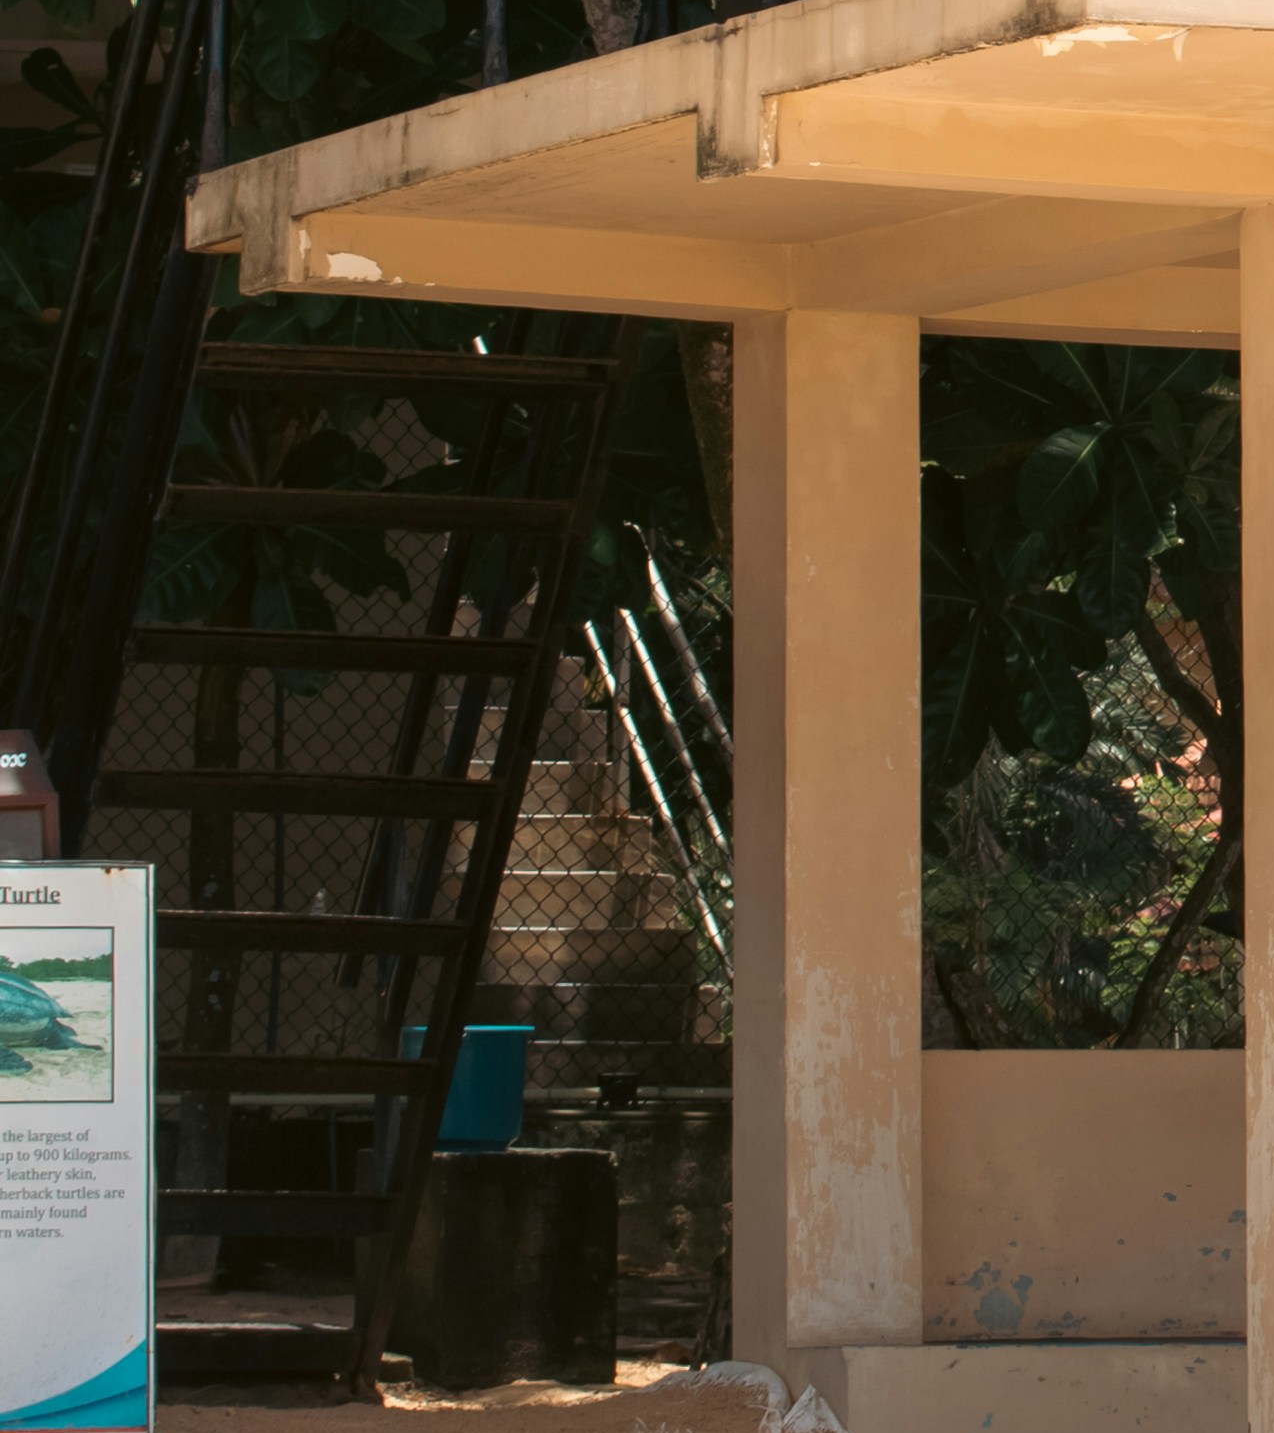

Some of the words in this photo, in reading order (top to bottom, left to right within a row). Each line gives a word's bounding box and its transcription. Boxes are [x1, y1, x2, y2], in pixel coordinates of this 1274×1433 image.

[0, 885, 61, 905] Turtle
[2, 1129, 25, 1143] the
[27, 1129, 73, 1145] largest
[75, 1128, 91, 1142] of
[17, 1150, 31, 1162] to
[33, 1148, 60, 1161] 900
[62, 1147, 133, 1164] kilograms.
[6, 1168, 62, 1184] leathery
[64, 1167, 97, 1181] skin,
[56, 1186, 101, 1200] turtles
[103, 1189, 126, 1199] are
[0, 1206, 46, 1222] mainly
[48, 1205, 88, 1219] found
[15, 1227, 65, 1238] waters.
